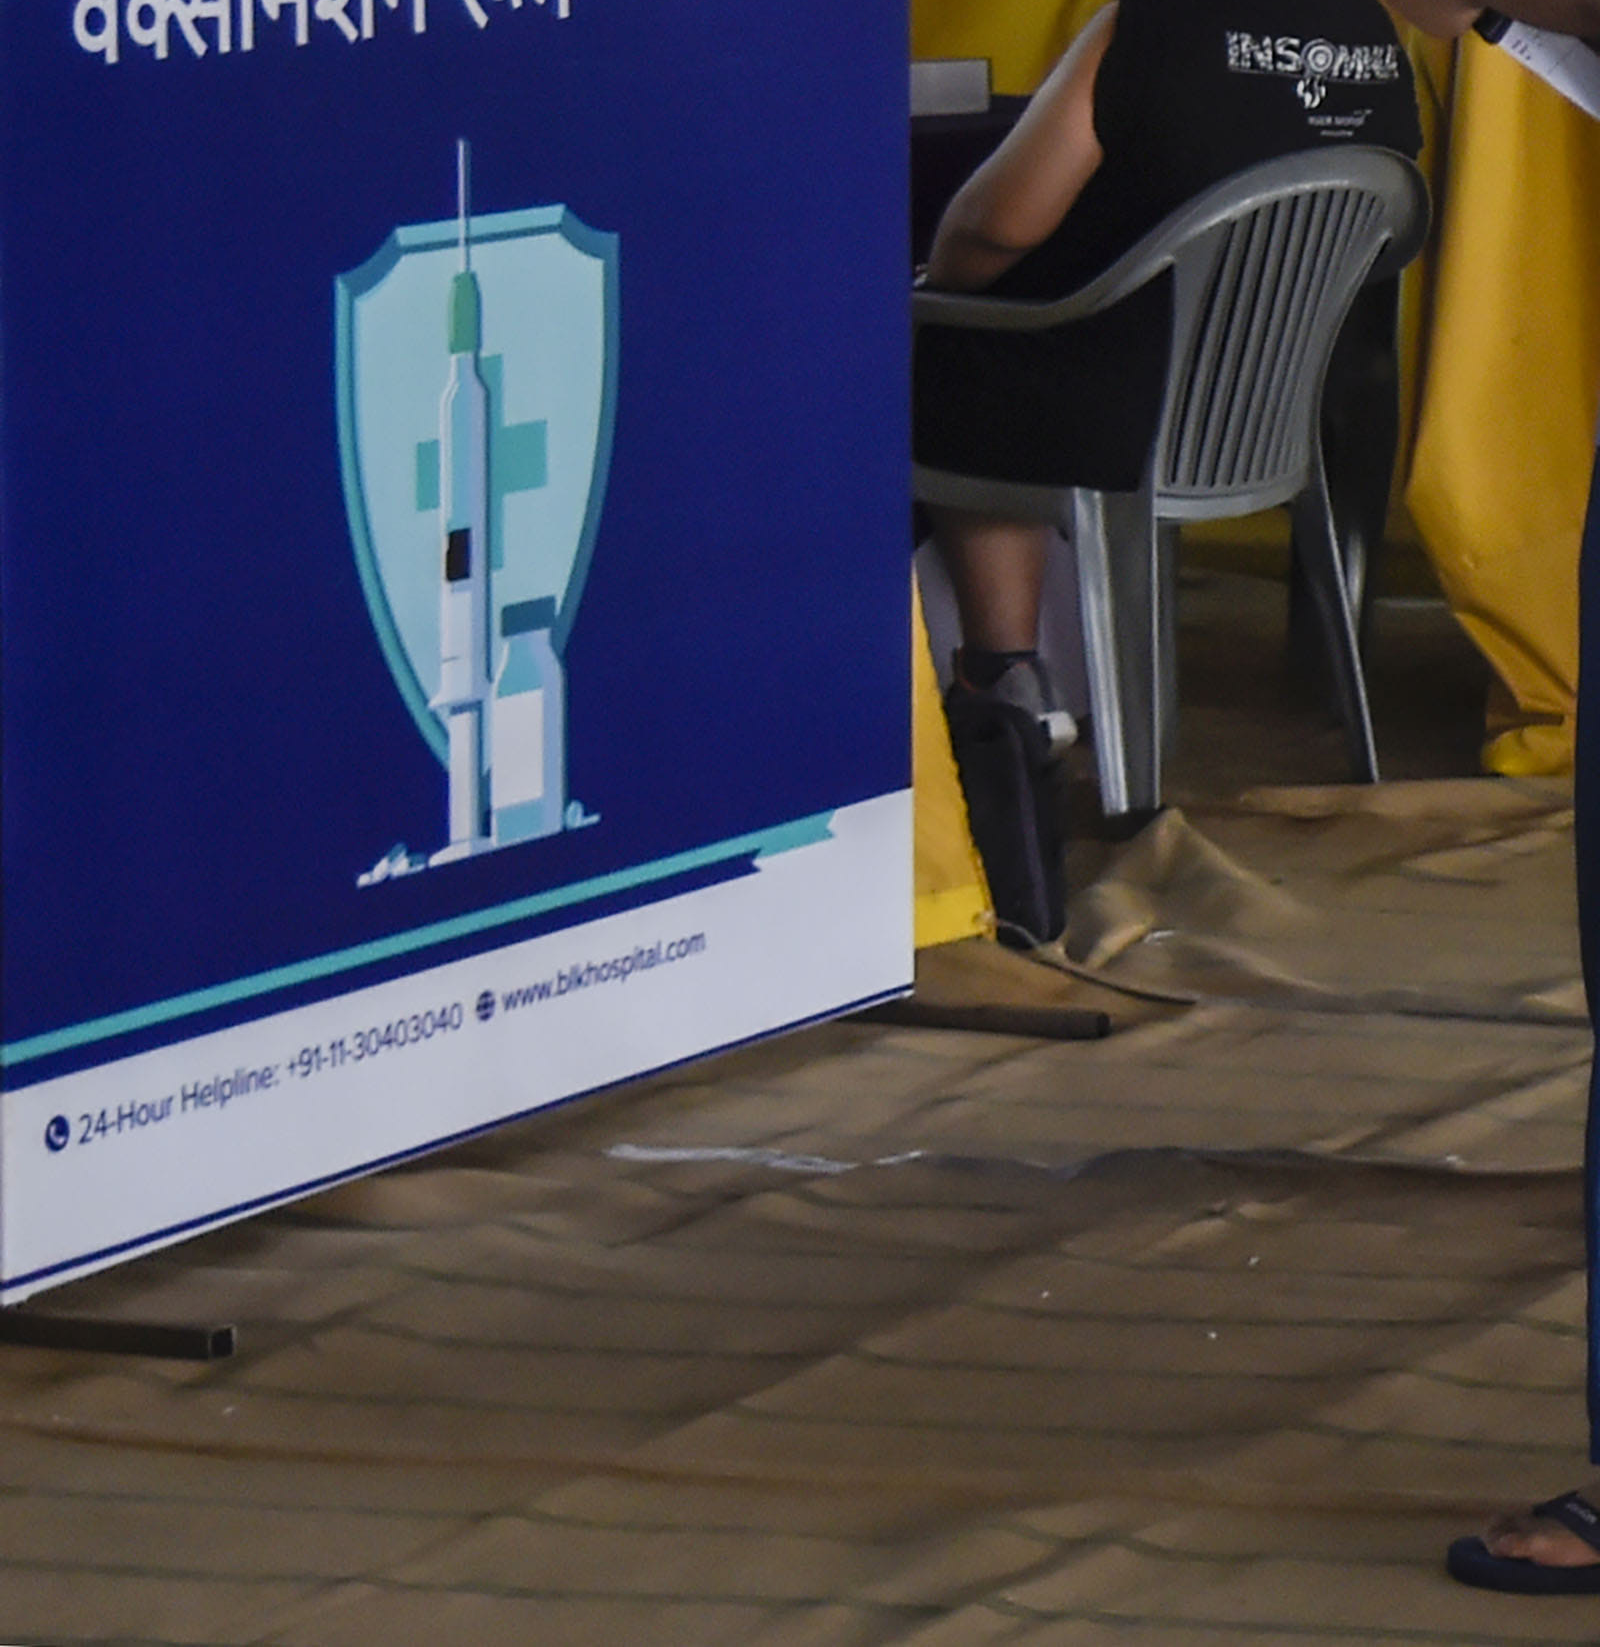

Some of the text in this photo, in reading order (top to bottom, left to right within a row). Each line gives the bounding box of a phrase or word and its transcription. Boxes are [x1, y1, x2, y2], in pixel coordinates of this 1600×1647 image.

[77, 932, 707, 1146] 24-Hour Helpline: +91-11-30403040 www.blkhospital.com
